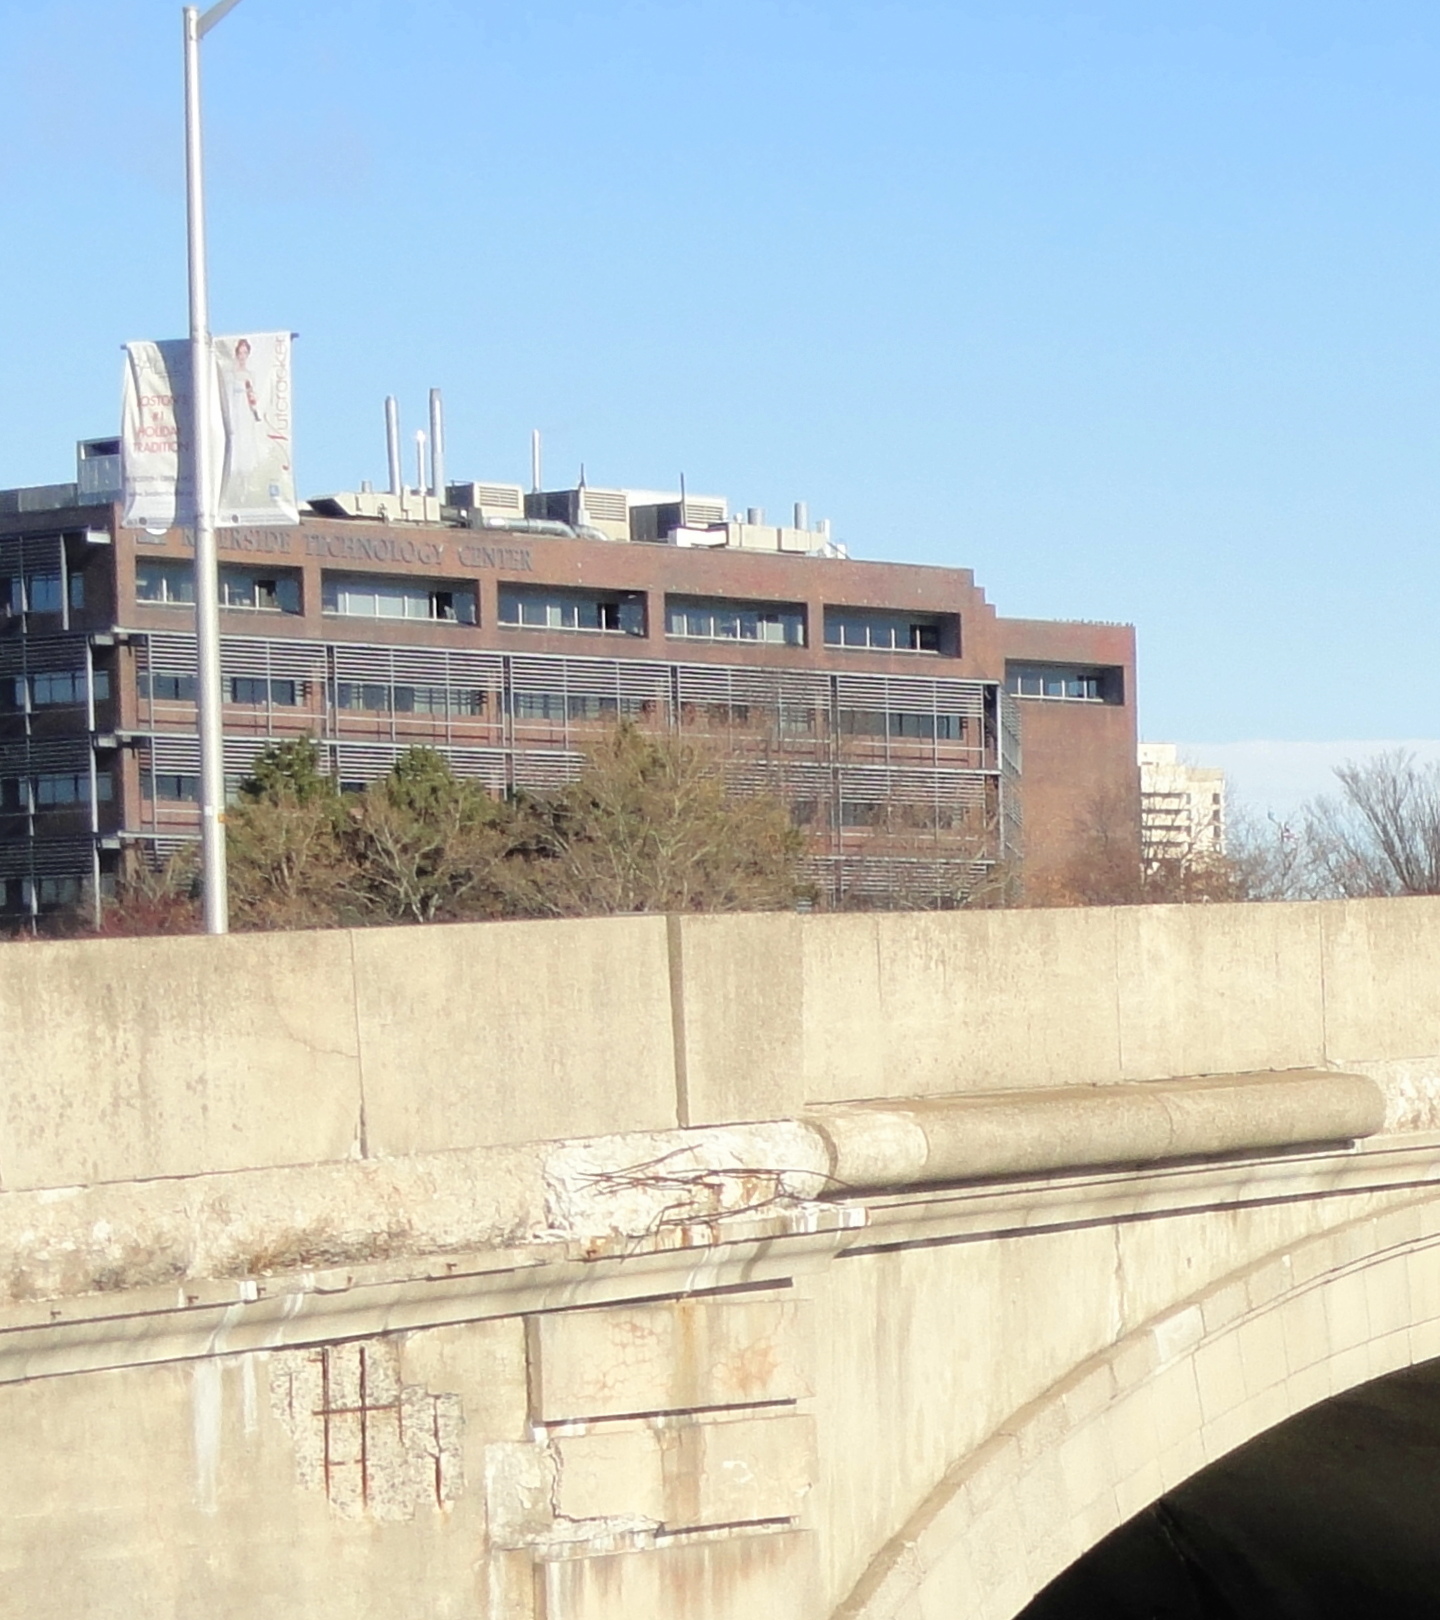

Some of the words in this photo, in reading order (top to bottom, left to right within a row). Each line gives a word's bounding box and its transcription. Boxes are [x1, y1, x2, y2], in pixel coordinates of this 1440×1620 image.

[263, 334, 291, 471] Nutcracker
[181, 527, 292, 555] RERSIDE
[304, 533, 443, 566] TECHNOLOGY
[457, 543, 533, 572] CENTER
